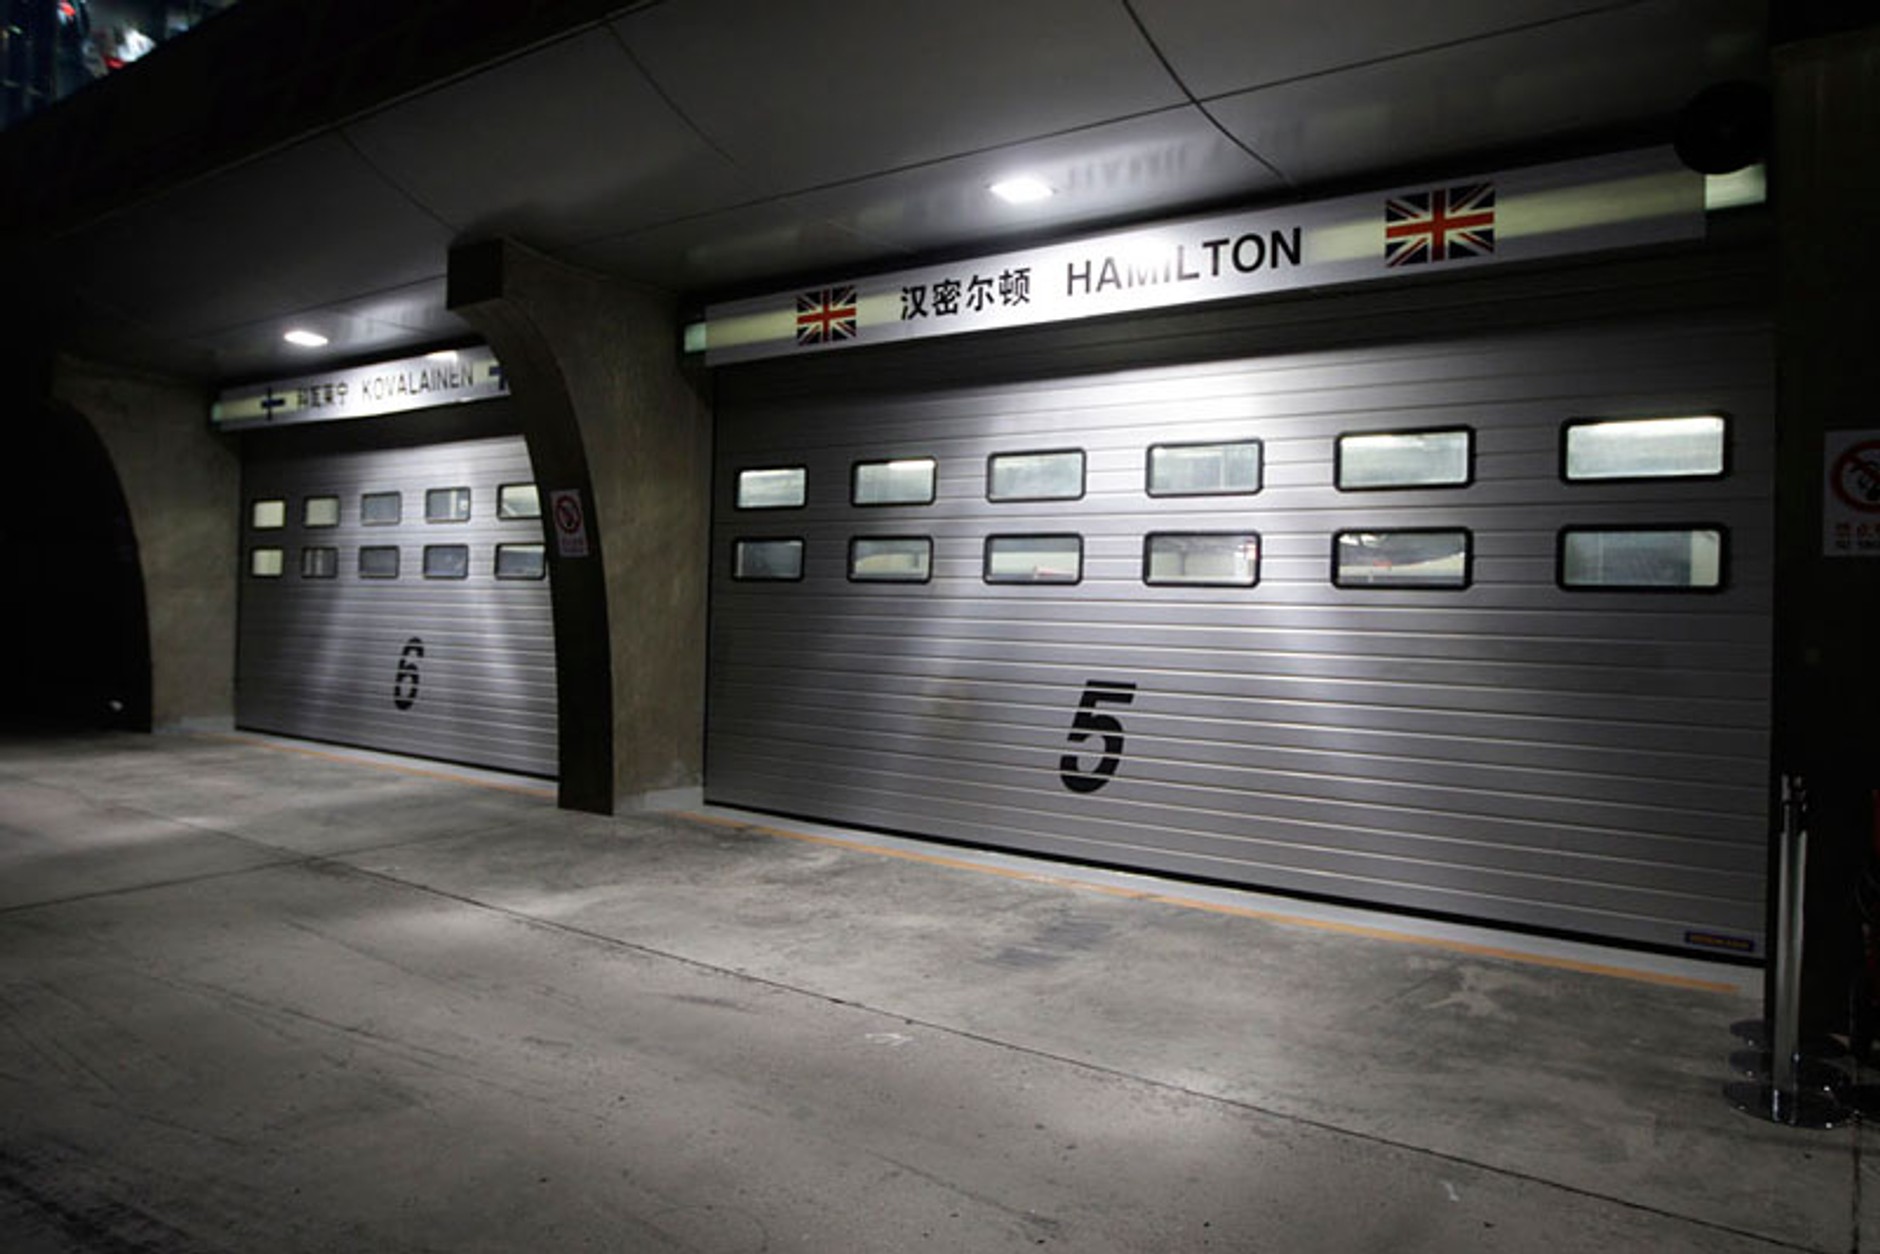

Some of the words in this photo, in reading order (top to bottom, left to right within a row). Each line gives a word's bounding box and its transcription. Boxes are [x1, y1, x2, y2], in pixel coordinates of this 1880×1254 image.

[900, 266, 1031, 321] 汉密尔顿
[1066, 226, 1302, 297] HAMILTON
[361, 364, 474, 404] KOVALAINEN
[395, 637, 424, 711] 6
[1060, 680, 1136, 793] 5
